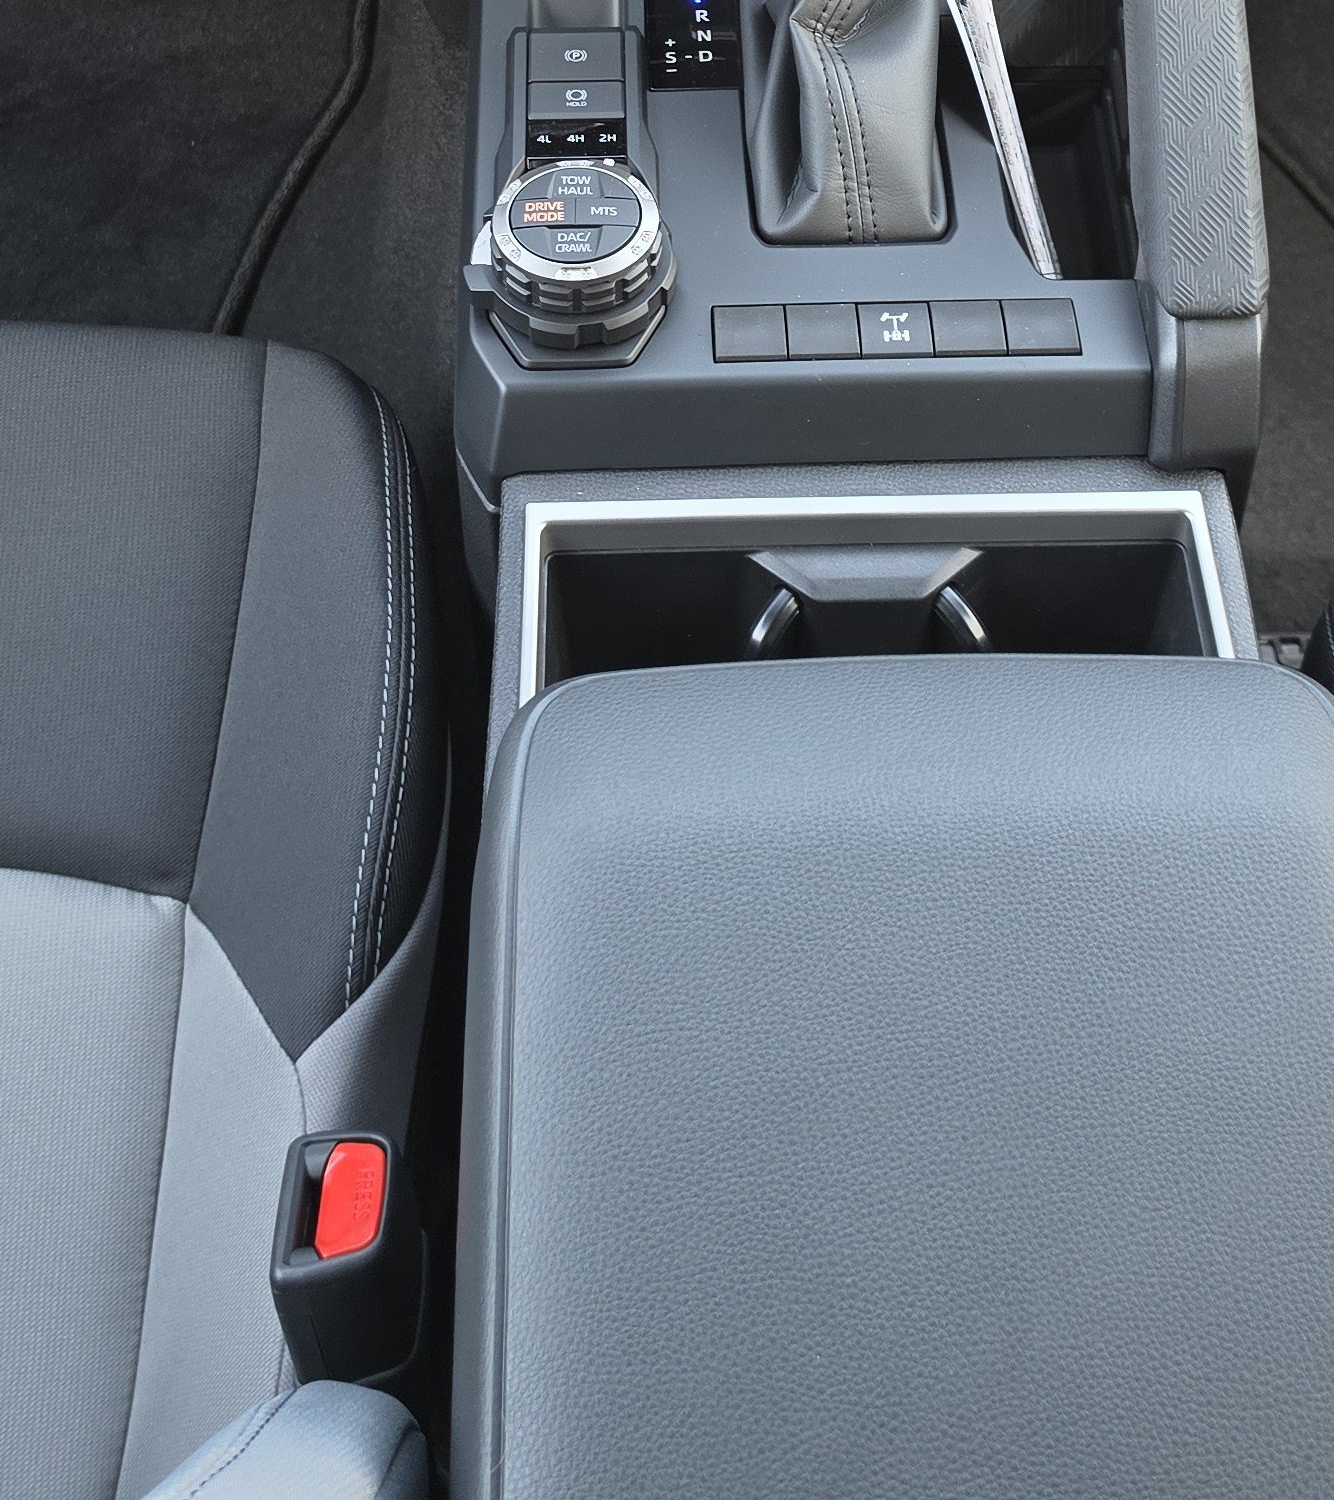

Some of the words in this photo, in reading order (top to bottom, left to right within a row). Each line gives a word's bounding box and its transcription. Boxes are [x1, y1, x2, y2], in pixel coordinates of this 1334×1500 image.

[695, 9, 710, 22] R
[697, 29, 712, 42] N
[665, 51, 677, 64] S
[698, 50, 713, 63] D
[536, 134, 552, 144] 4L
[566, 134, 585, 143] 4H
[598, 133, 617, 143] 2H
[560, 175, 592, 185] TOW
[558, 186, 594, 196] HAUL
[525, 201, 565, 212] DRIVE
[590, 206, 618, 216] MTS
[523, 212, 565, 223] MODE
[557, 232, 592, 242] DAC/
[555, 243, 593, 253] CRAWL
[353, 1171, 374, 1220] PRESS
